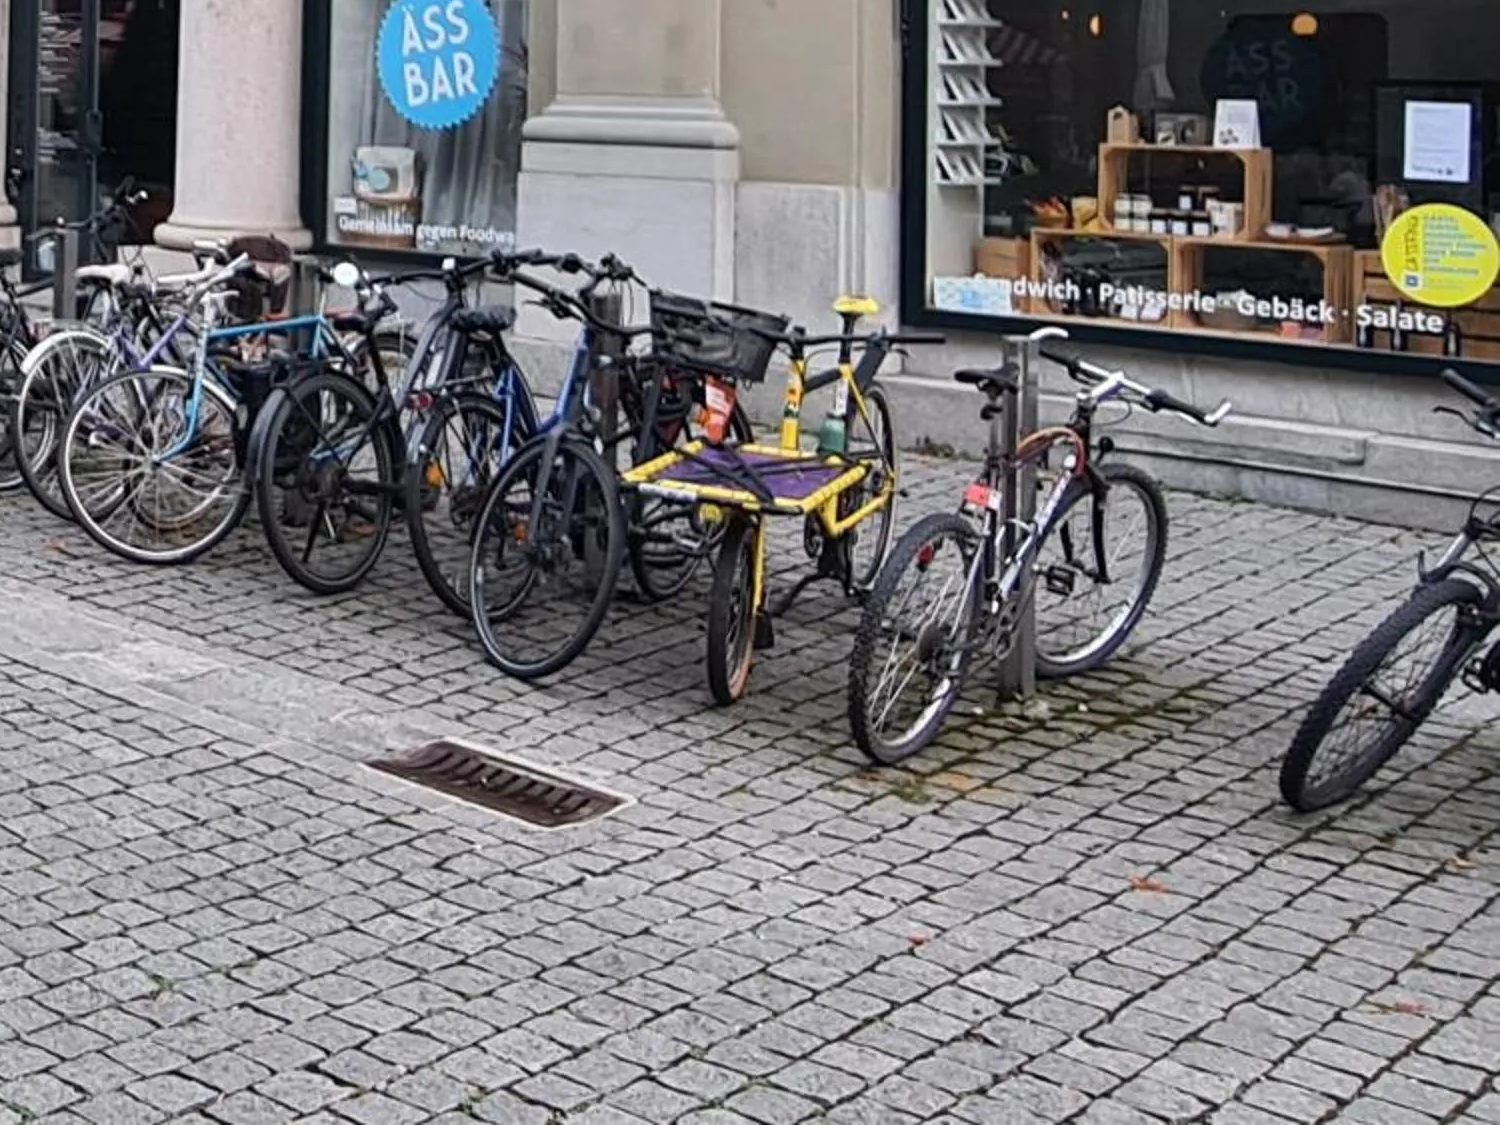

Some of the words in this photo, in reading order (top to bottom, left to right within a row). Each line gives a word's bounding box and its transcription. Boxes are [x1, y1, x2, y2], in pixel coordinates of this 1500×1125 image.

[403, 51, 479, 108] BAR
[973, 272, 1081, 301] ndwich
[1099, 281, 1216, 314] Patisserie
[1236, 289, 1336, 324] Gebäck
[1356, 304, 1445, 334] Salate
